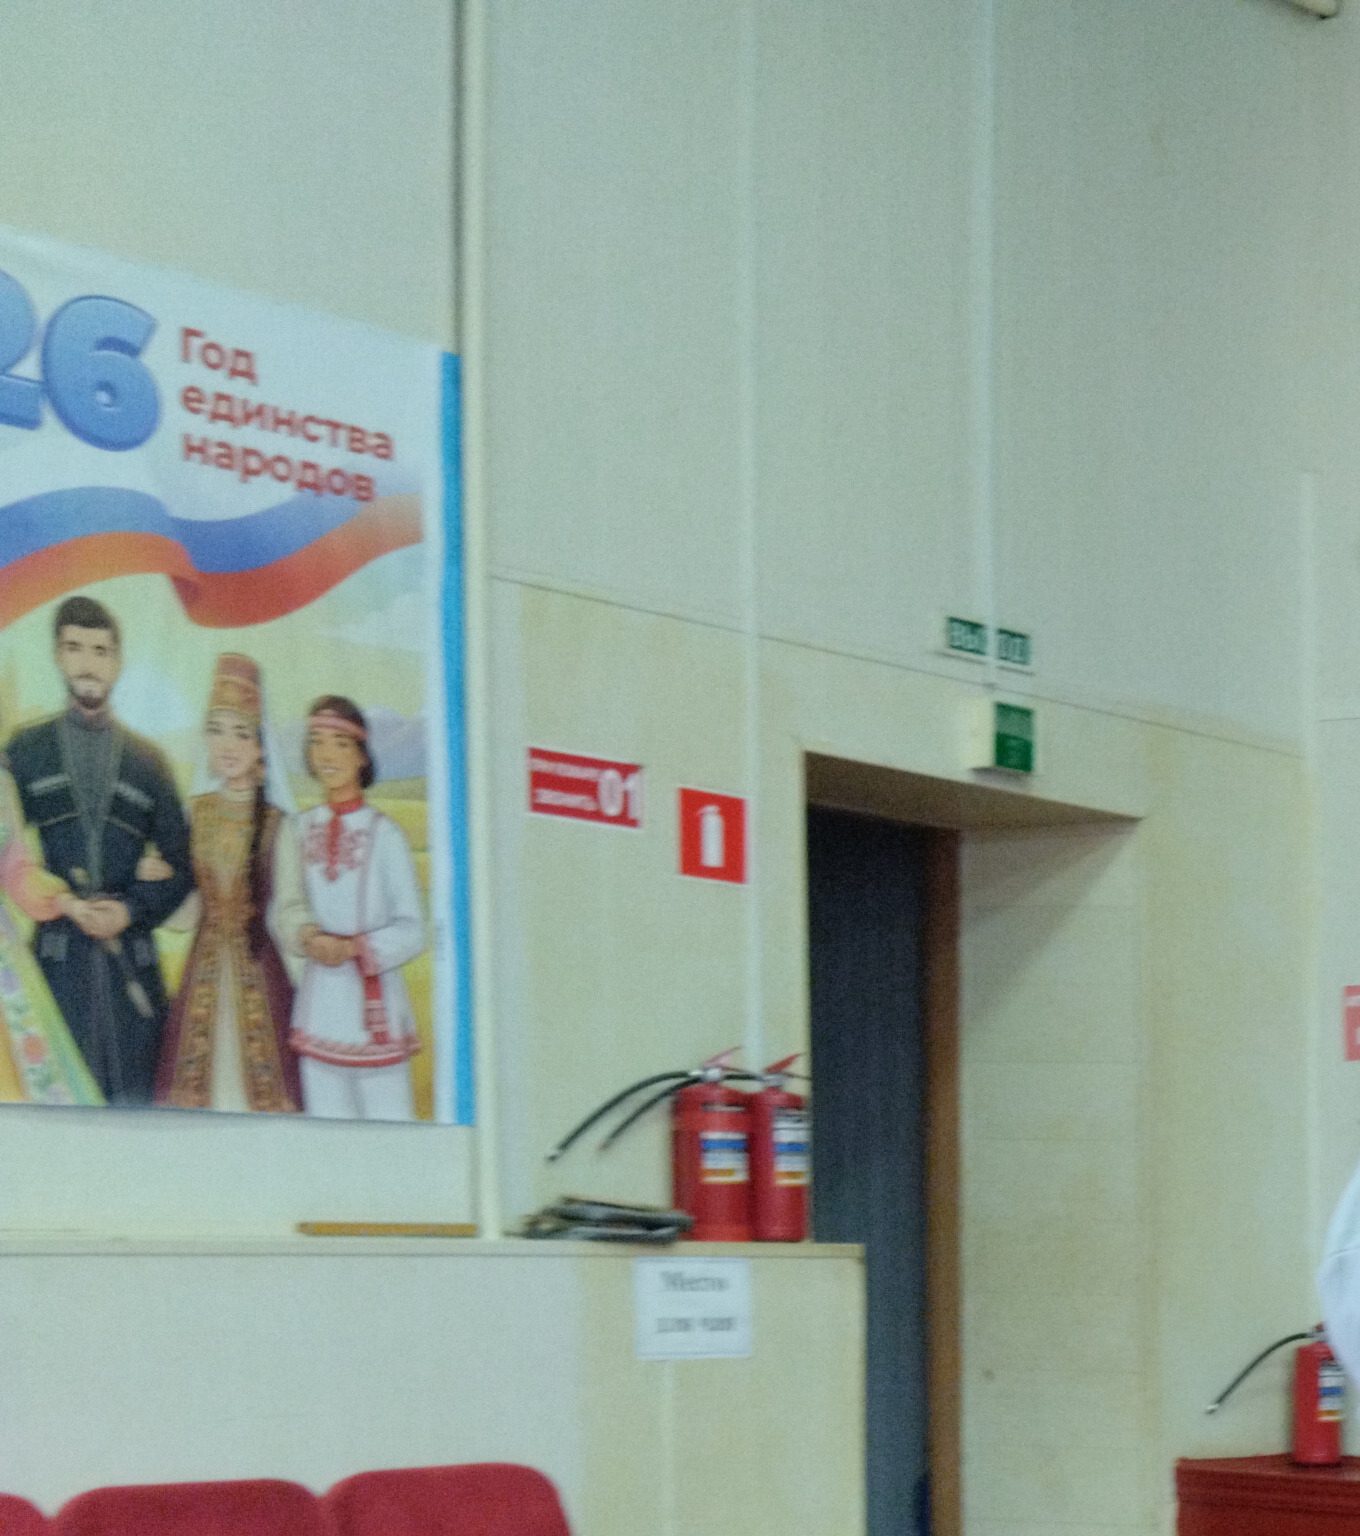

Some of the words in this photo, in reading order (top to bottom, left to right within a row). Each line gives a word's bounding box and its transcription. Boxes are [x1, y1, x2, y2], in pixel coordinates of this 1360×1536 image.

[181, 327, 259, 386] Год
[181, 385, 396, 461] единства
[181, 433, 376, 503] народов
[599, 769, 642, 818] 01
